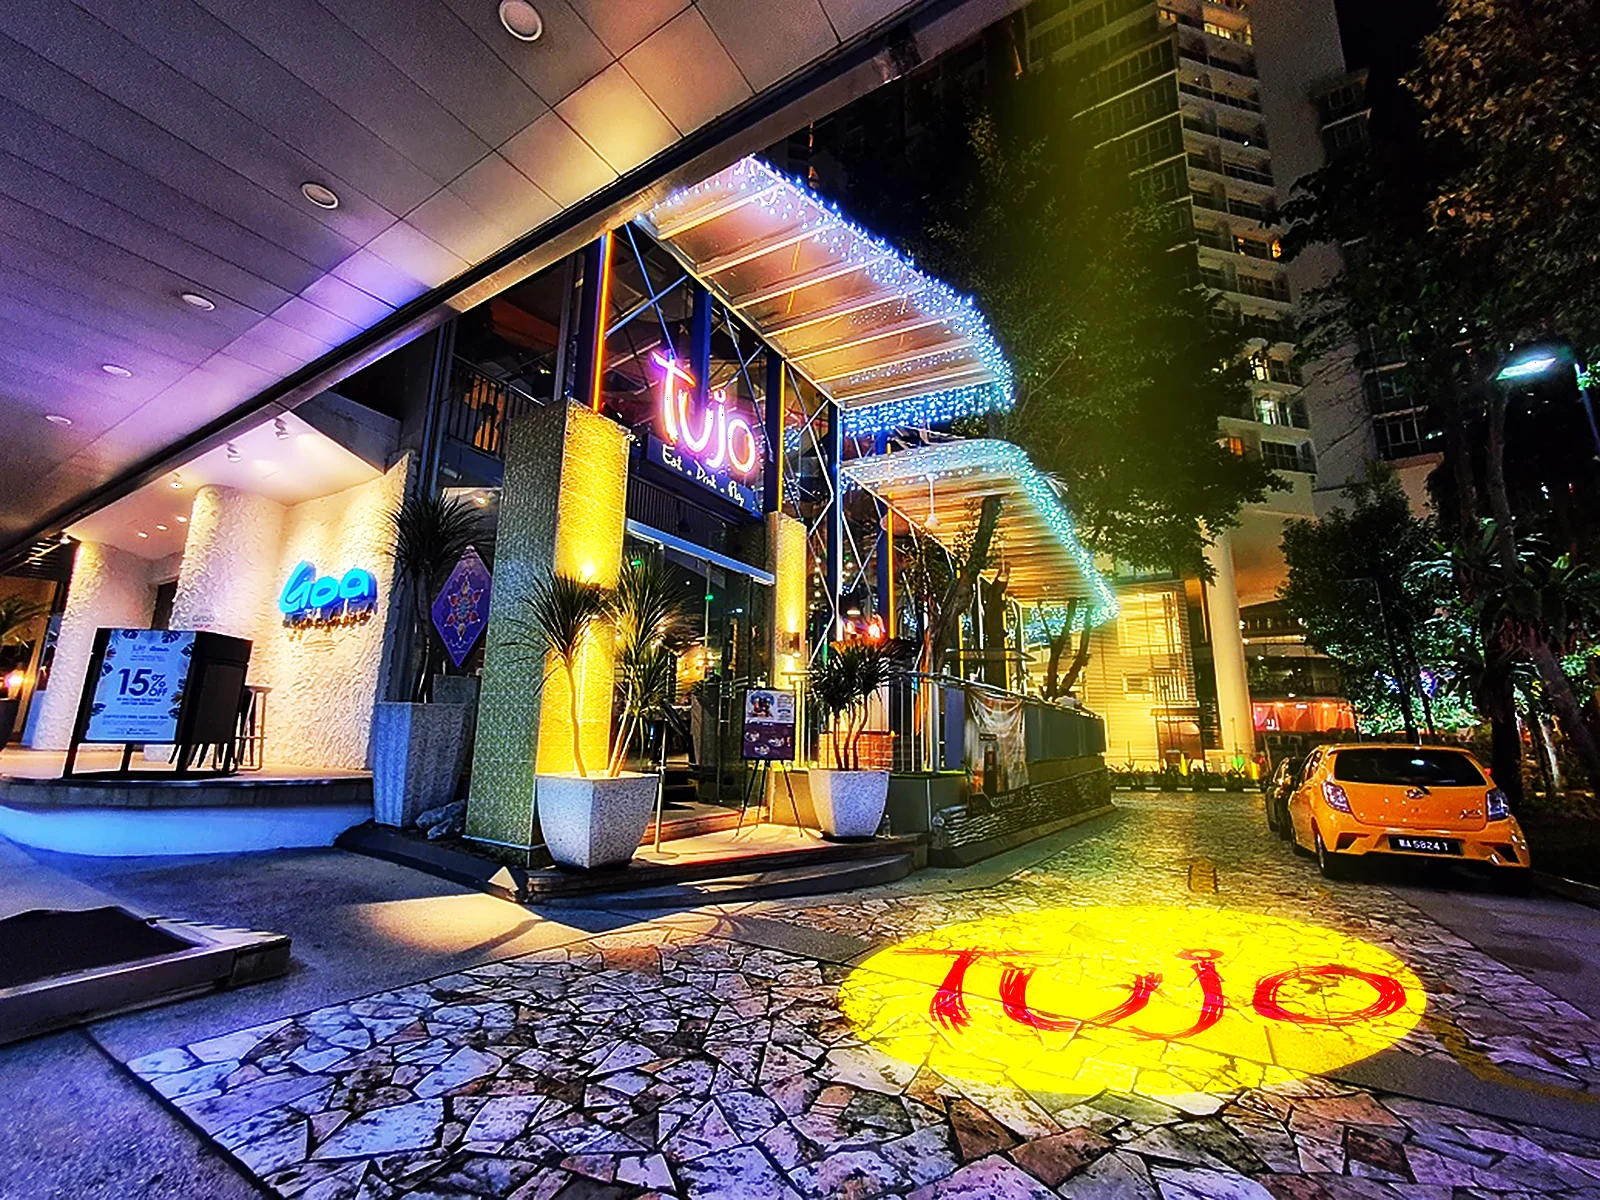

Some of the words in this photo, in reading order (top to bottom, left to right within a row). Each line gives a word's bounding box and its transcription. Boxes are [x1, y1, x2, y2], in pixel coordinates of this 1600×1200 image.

[662, 444, 683, 471] Eat
[279, 560, 376, 614] Goa
[118, 668, 166, 697] 15%
